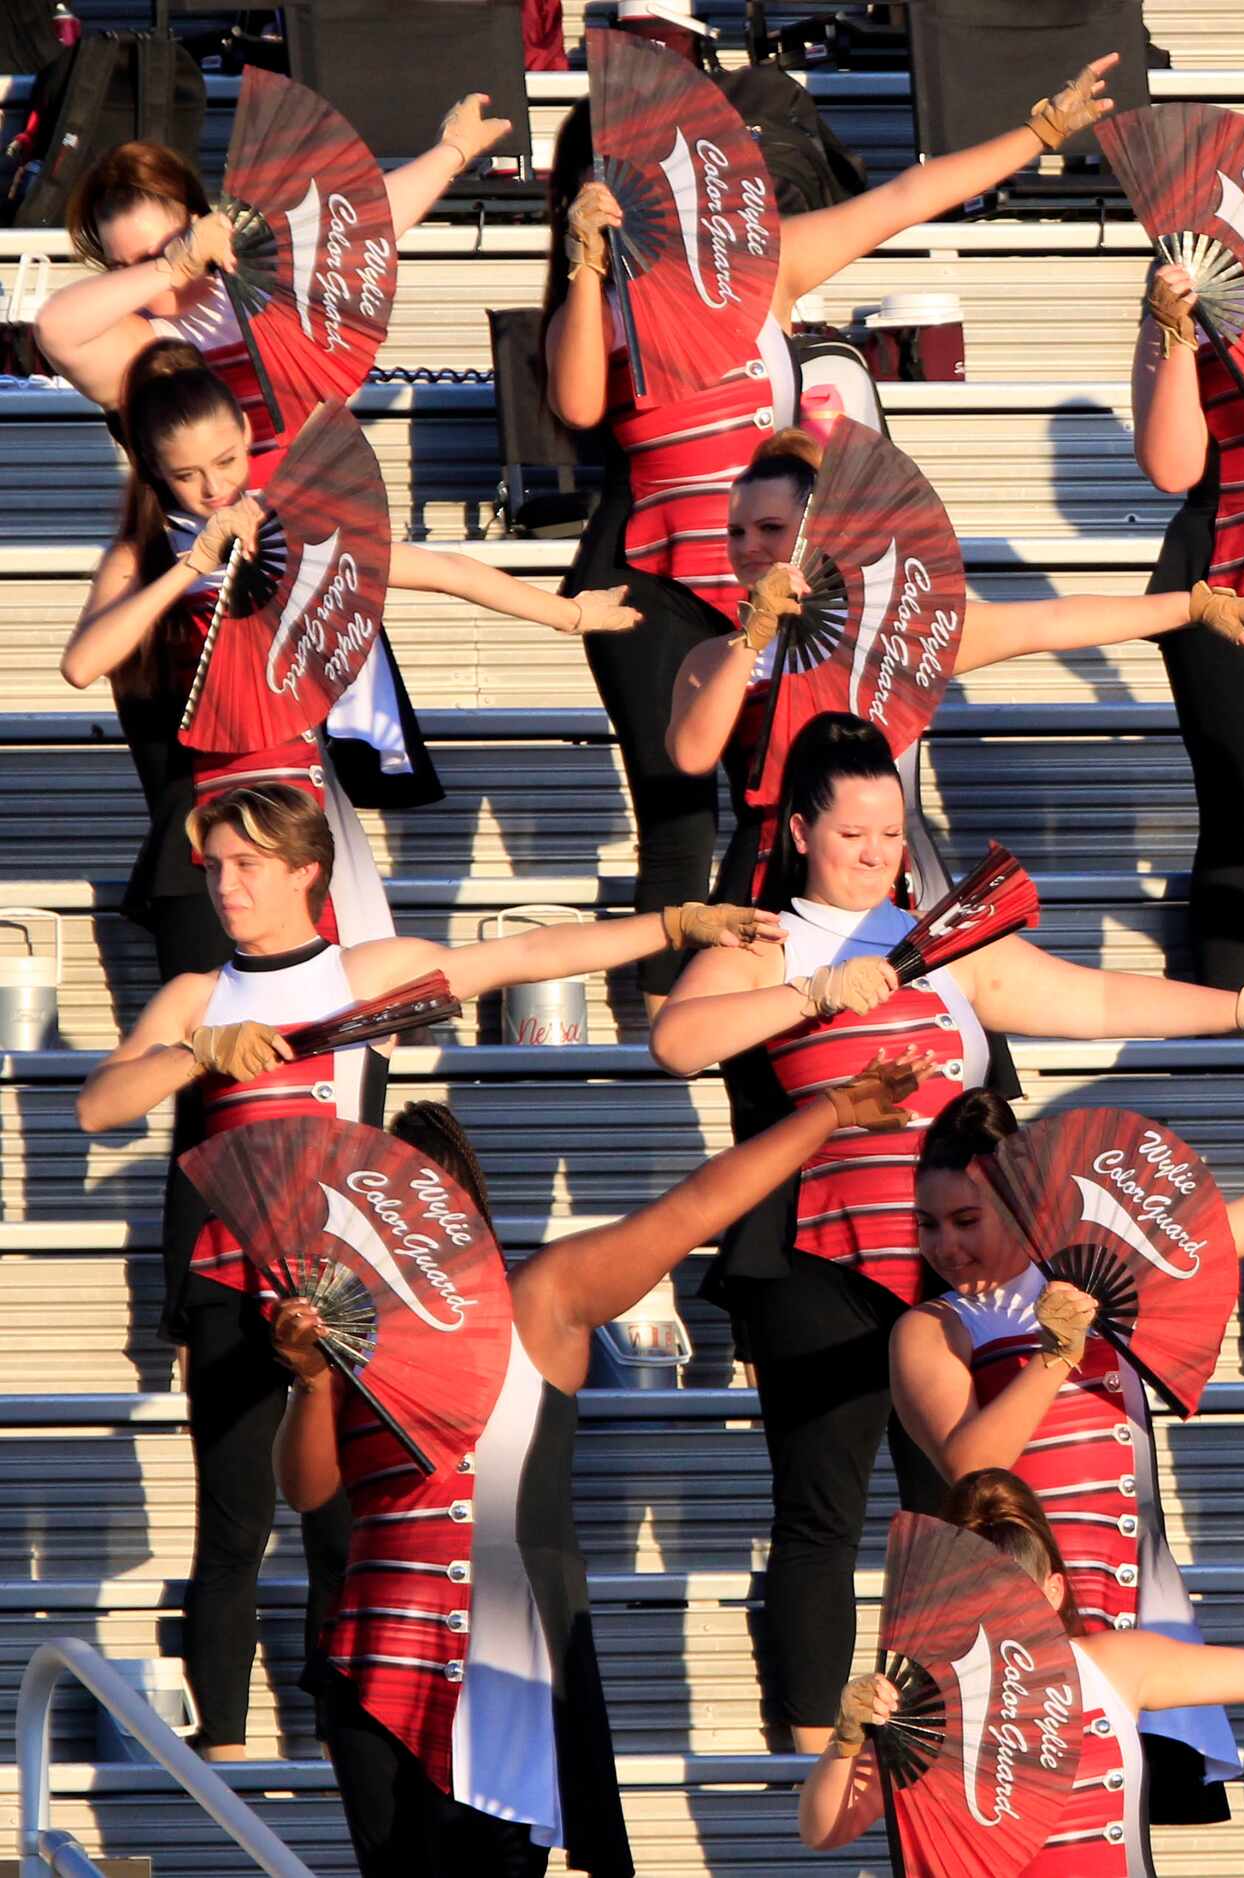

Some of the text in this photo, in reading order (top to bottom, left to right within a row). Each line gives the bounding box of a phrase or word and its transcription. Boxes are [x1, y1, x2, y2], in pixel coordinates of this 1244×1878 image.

[696, 139, 742, 302] Color Guard
[737, 177, 770, 256] Wylie
[315, 193, 357, 350] Color Guard
[355, 237, 390, 318] Wylie
[282, 552, 358, 702] Color Guard
[325, 612, 372, 681] Wylie
[869, 557, 931, 726] Color Guard
[916, 609, 958, 688] Wylie
[409, 1168, 472, 1246] Wylie
[1093, 1149, 1207, 1258] Color Guard
[1139, 1130, 1196, 1194] Wylie
[346, 1170, 479, 1314] Color Guard
[988, 1639, 1035, 1820] Color Guard
[1034, 1684, 1073, 1769] Wylie
